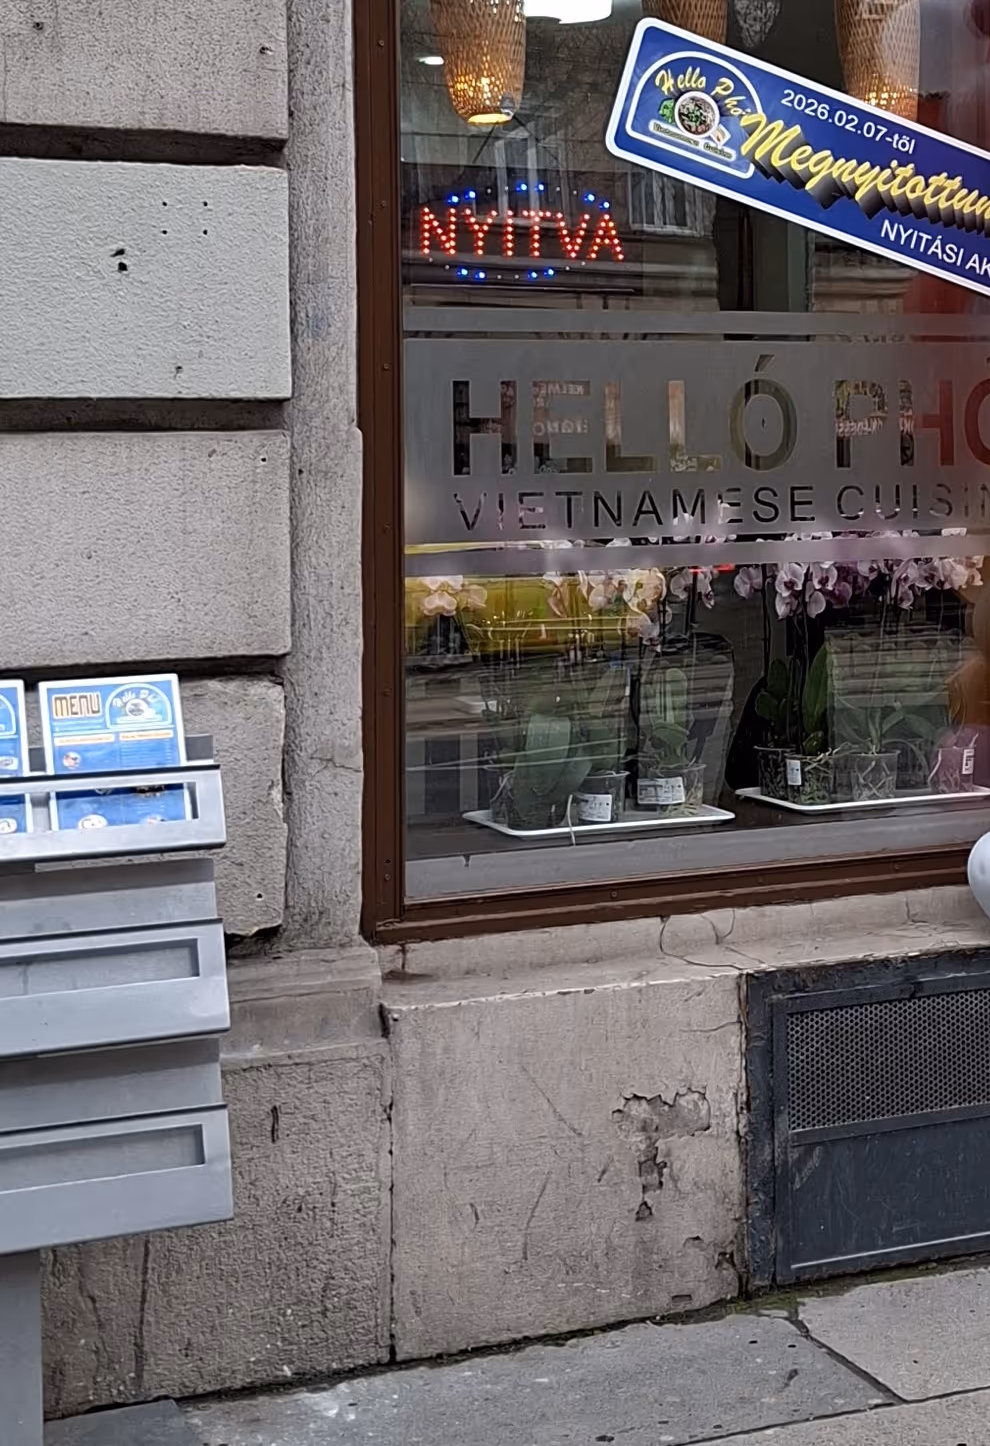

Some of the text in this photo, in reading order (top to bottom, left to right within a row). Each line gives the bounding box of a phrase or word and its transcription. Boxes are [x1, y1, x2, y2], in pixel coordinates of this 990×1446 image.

[655, 66, 707, 95] Hello
[780, 89, 915, 155] 2026.02.07-től
[420, 206, 625, 261] NYITVA
[881, 219, 964, 266] NYITÁSI
[452, 353, 798, 476] HELLÓ
[453, 486, 815, 531] VIETNAMESE
[55, 694, 100, 716] MENU
